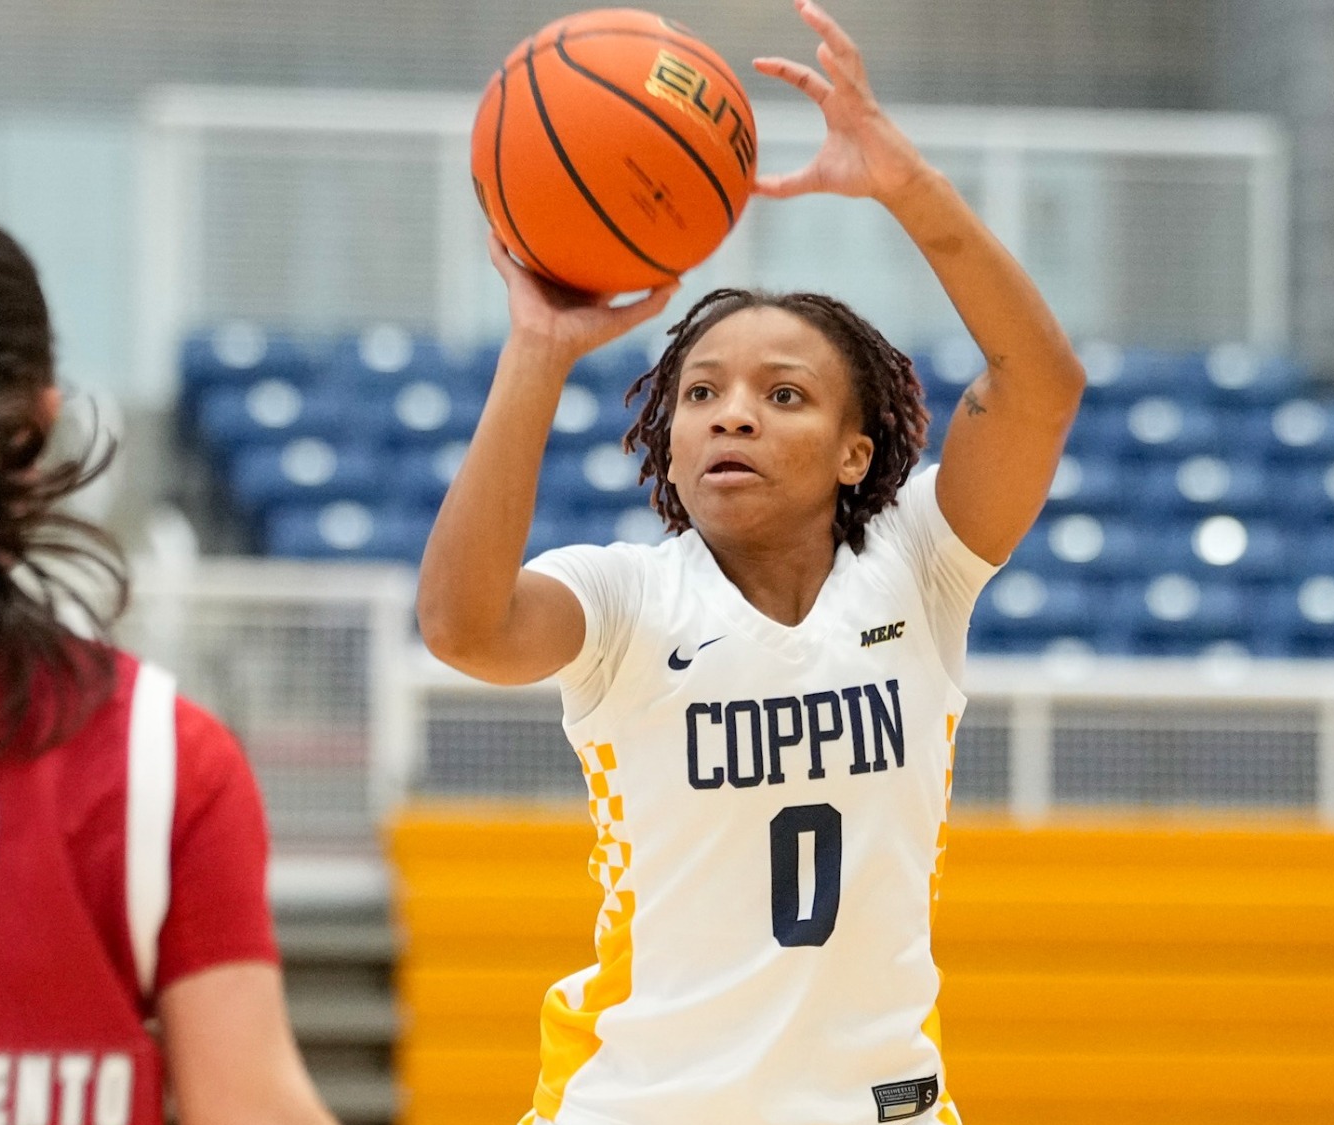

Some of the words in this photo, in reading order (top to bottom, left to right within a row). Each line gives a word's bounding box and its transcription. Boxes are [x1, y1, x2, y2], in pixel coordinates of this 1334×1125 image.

[860, 620, 905, 648] MEAC
[686, 679, 905, 789] COPPIN
[770, 803, 842, 947] 0
